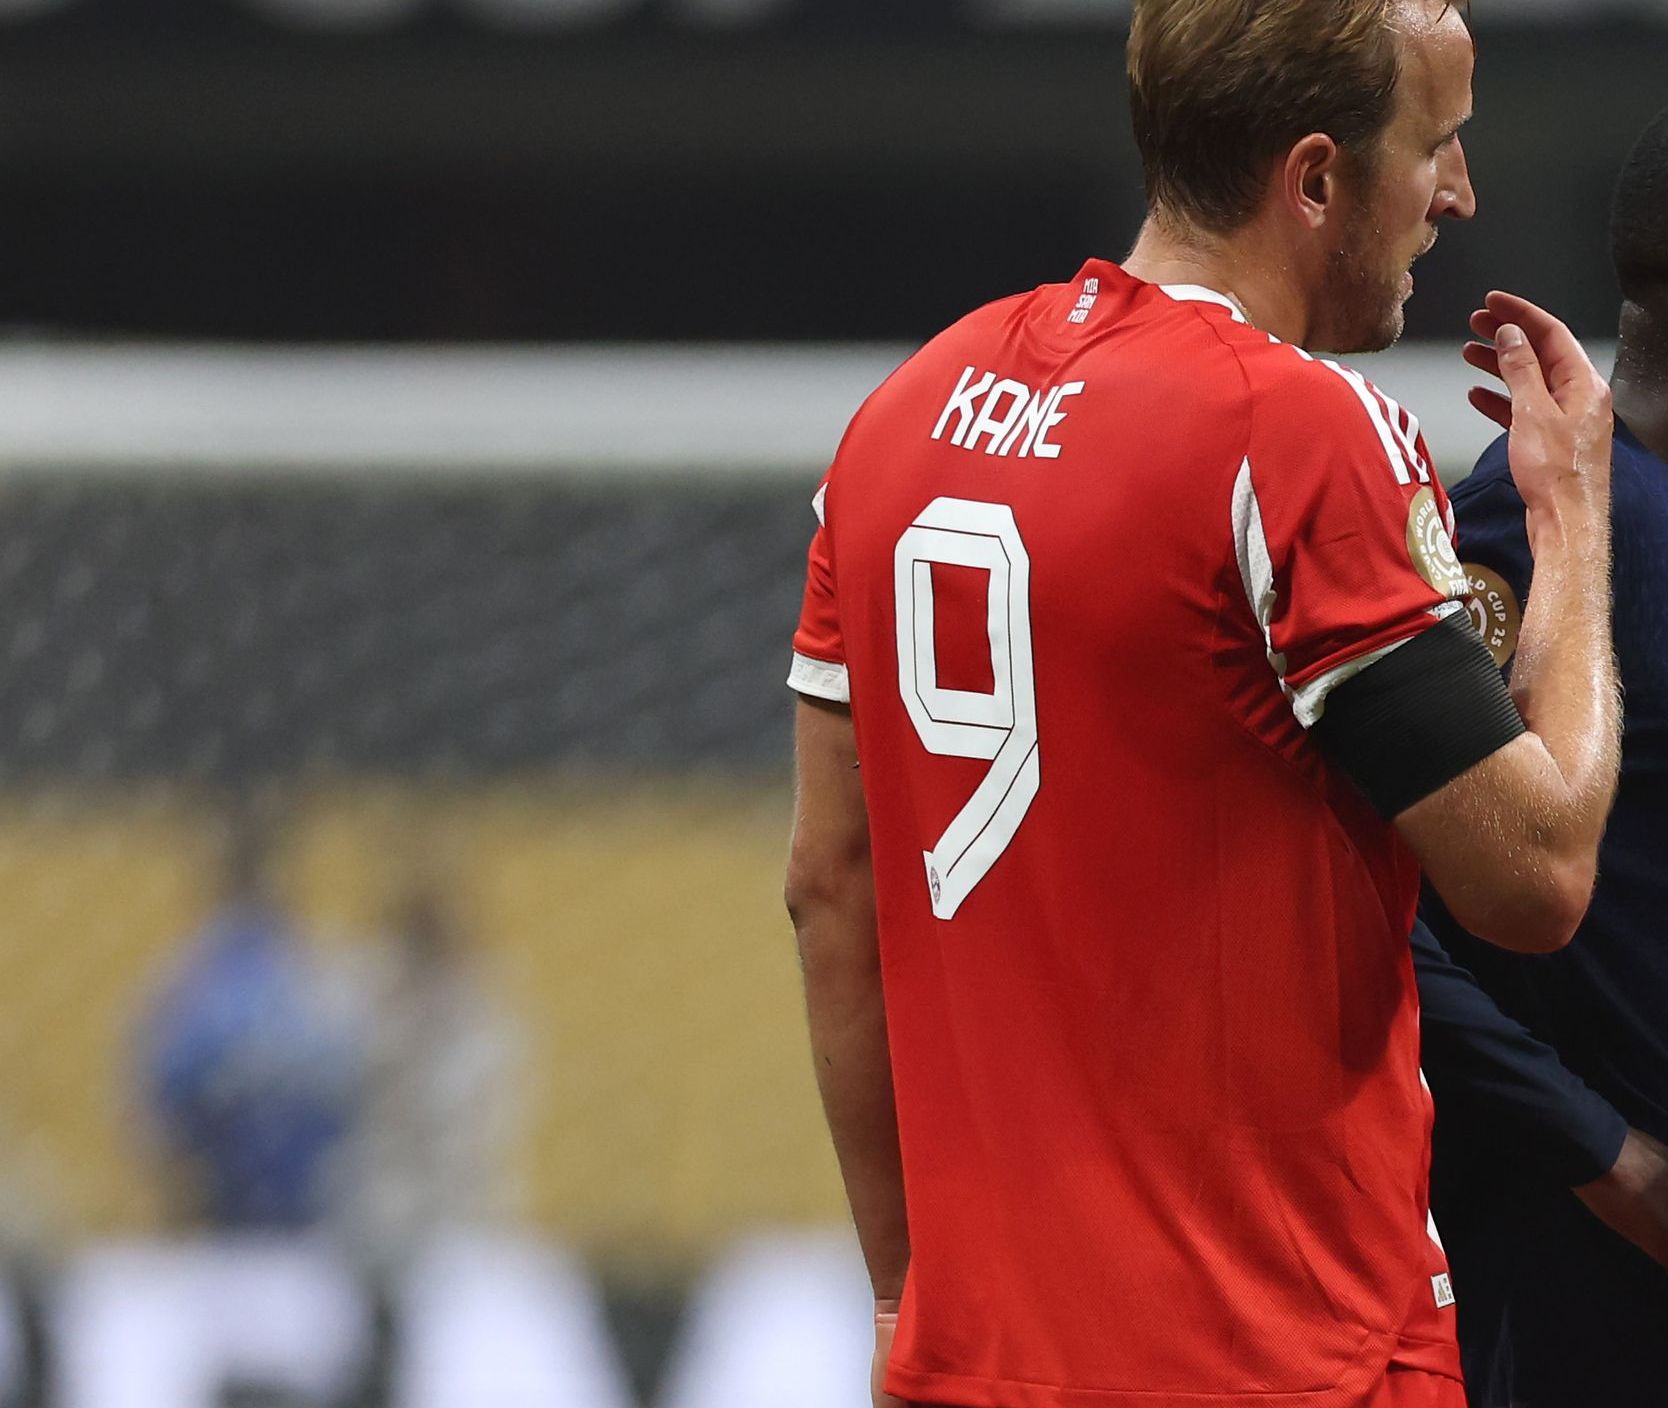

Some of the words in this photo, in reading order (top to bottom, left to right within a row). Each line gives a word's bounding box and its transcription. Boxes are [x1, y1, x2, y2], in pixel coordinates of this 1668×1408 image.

[1083, 278, 1099, 293] MIA
[1075, 294, 1097, 309] SAN
[1066, 309, 1089, 324] MIA
[930, 365, 1086, 459] KANE
[1487, 590, 1506, 623] CUP
[1490, 628, 1506, 648] 25
[893, 495, 1041, 920] 9
